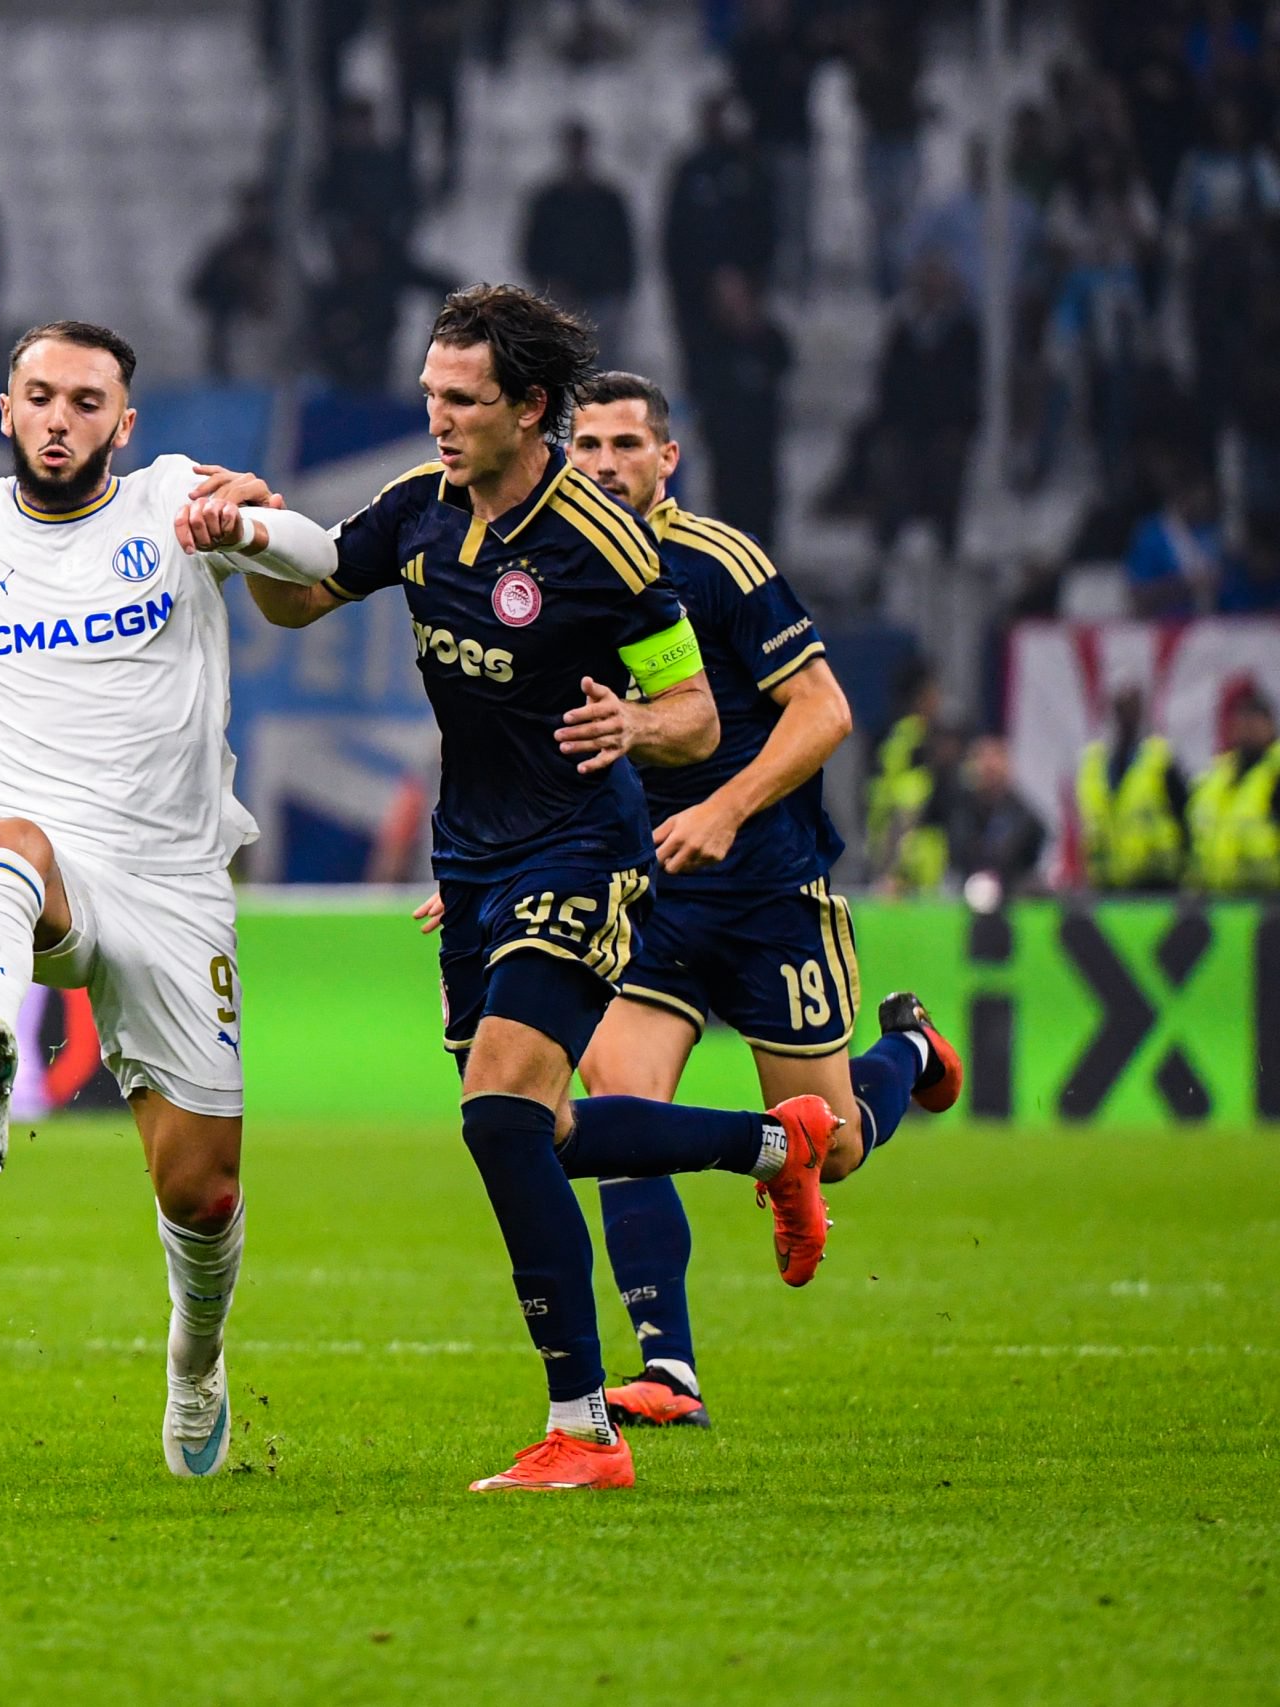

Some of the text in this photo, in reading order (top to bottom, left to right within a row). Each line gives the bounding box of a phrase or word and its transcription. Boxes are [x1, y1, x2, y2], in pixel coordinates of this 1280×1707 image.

[84, 591, 174, 644] CGM
[514, 890, 598, 940] 45
[209, 954, 237, 1024] 9
[779, 959, 832, 1032] 19
[762, 1131, 787, 1151] CTO
[520, 1297, 549, 1316] 25
